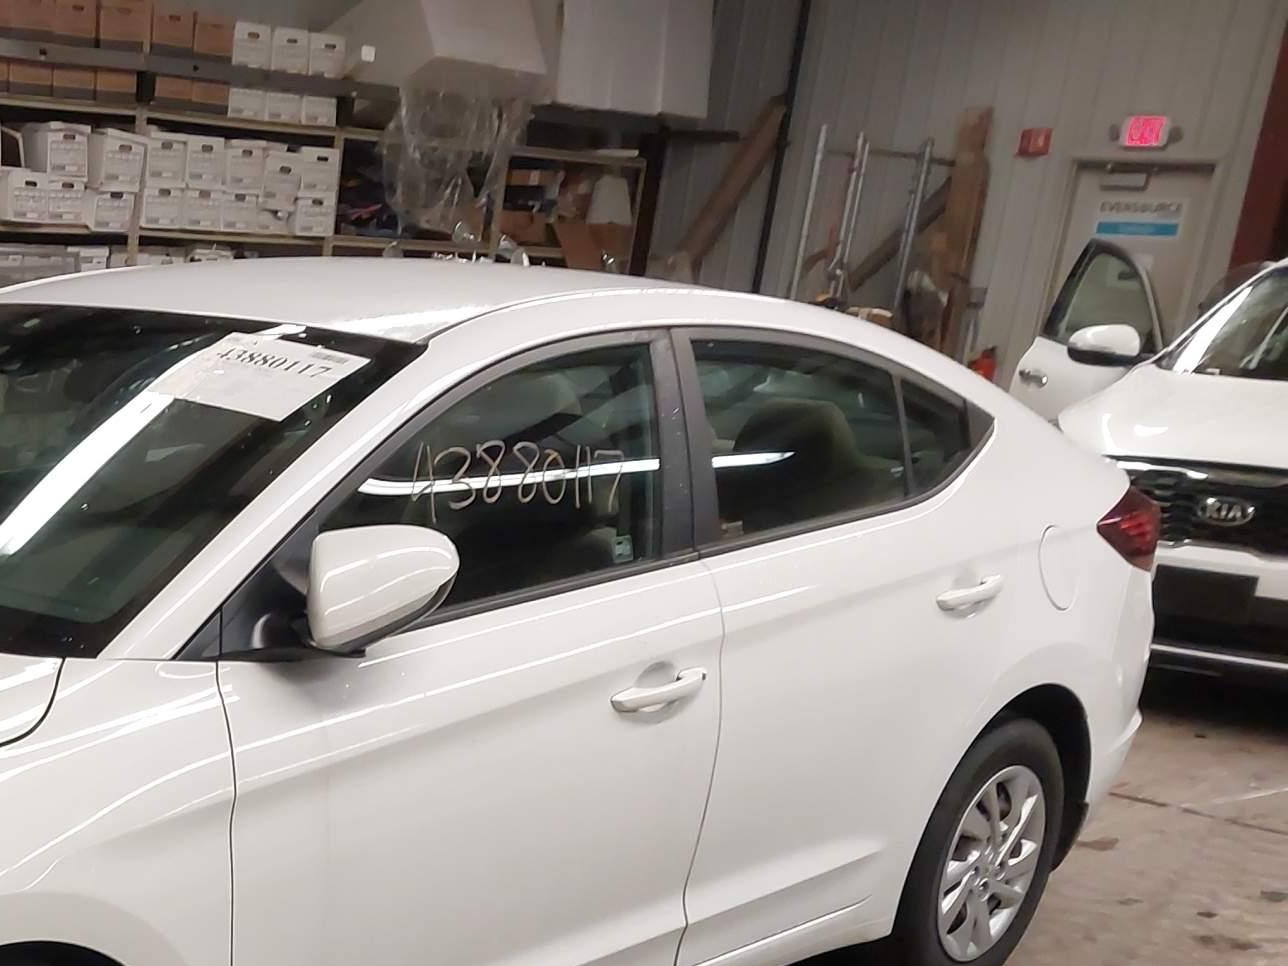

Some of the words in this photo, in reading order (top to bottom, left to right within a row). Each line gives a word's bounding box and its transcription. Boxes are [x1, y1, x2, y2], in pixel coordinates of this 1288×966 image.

[216, 347, 333, 378] 43880117
[410, 440, 625, 524] 43880117
[1205, 499, 1244, 520] KIA
